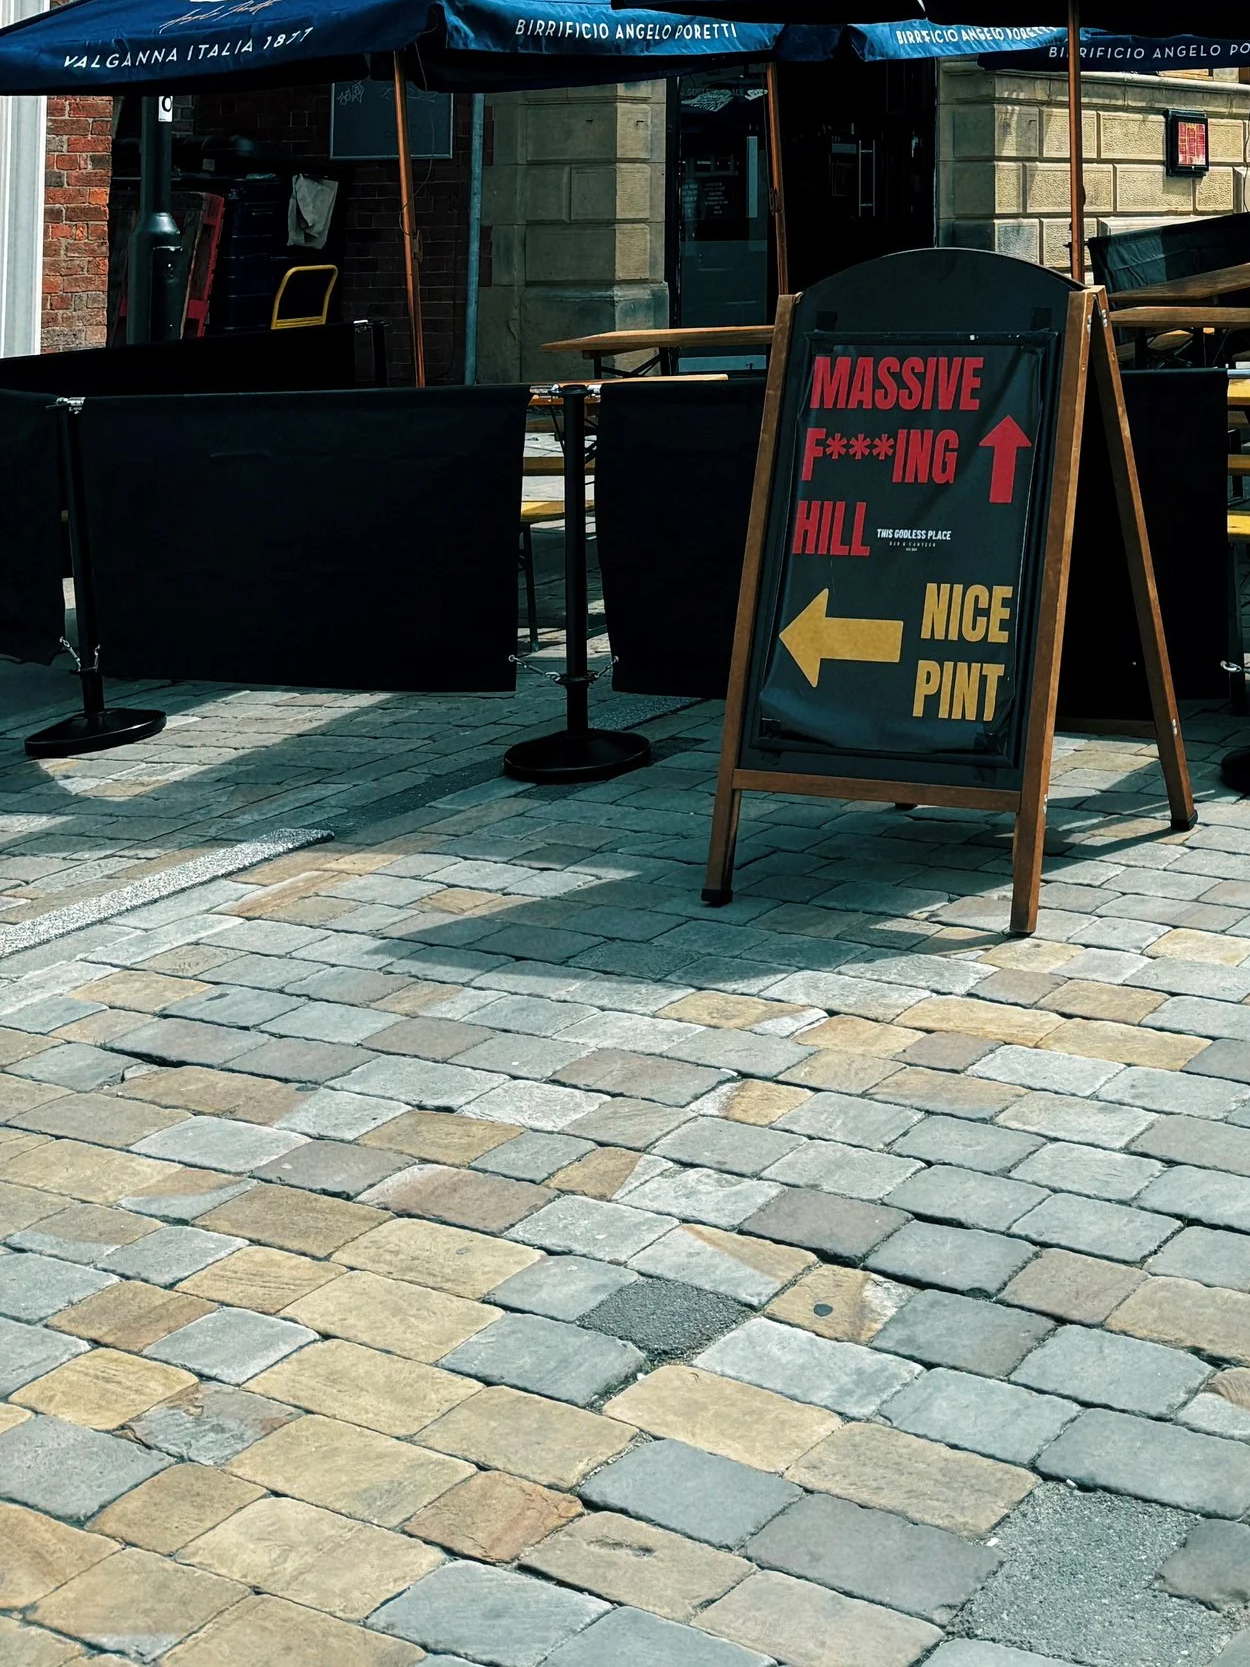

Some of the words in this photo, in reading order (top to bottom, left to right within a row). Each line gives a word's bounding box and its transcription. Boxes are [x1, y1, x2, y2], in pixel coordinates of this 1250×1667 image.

[515, 19, 609, 39] BIRRIFICIO
[615, 23, 671, 40] ANGELO
[675, 23, 737, 40] PORETTI
[64, 49, 177, 68] VALGANNA
[187, 38, 253, 61] ITALIA
[1153, 44, 1222, 60] ANGELO
[809, 355, 984, 411] MASSIVE
[791, 500, 870, 557] HILL
[877, 528, 893, 539] THIS
[894, 529, 926, 540] GODLESS
[927, 530, 952, 541] PLACE
[920, 582, 1014, 644] NICE
[912, 660, 1005, 721] PINT
